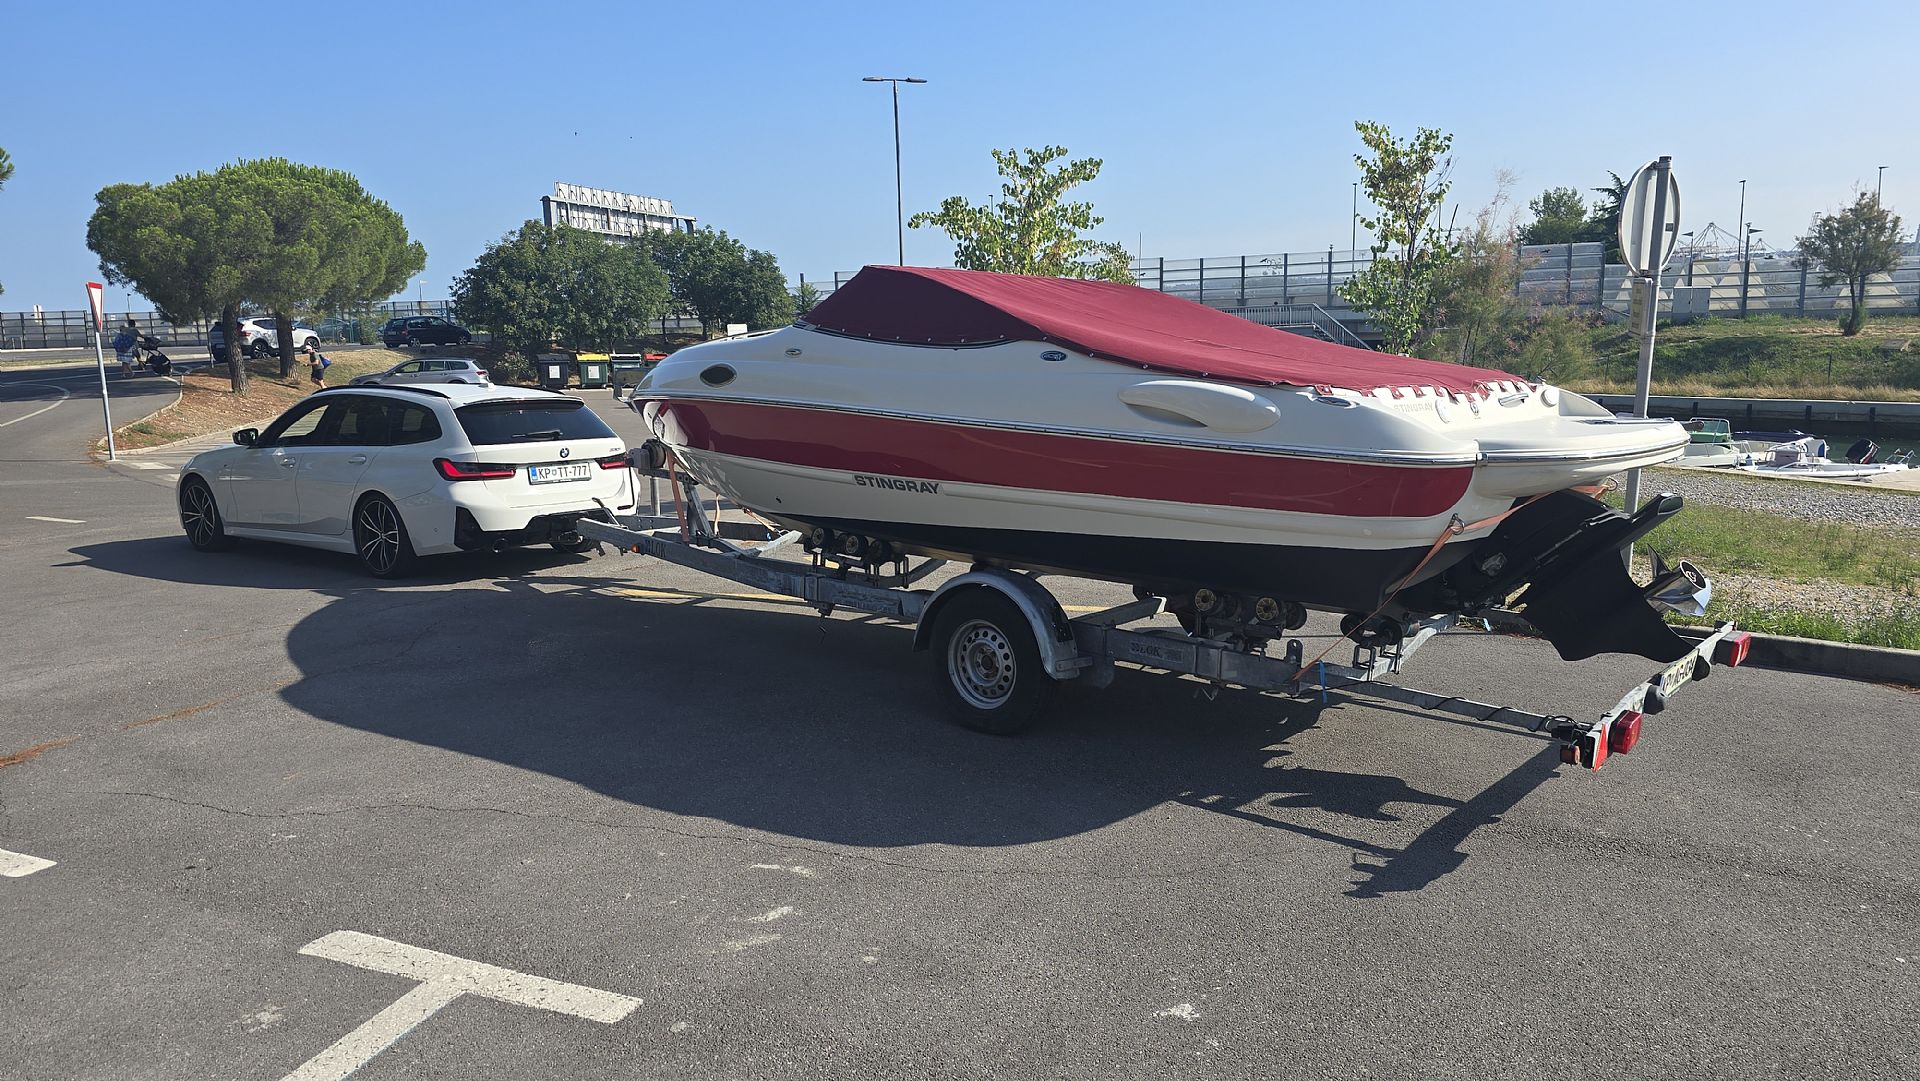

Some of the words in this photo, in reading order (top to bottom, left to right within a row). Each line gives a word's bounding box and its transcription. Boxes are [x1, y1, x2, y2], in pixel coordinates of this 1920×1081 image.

[538, 467, 551, 480] KP
[558, 465, 587, 478] TT-777
[854, 474, 940, 494] STINGRAY
